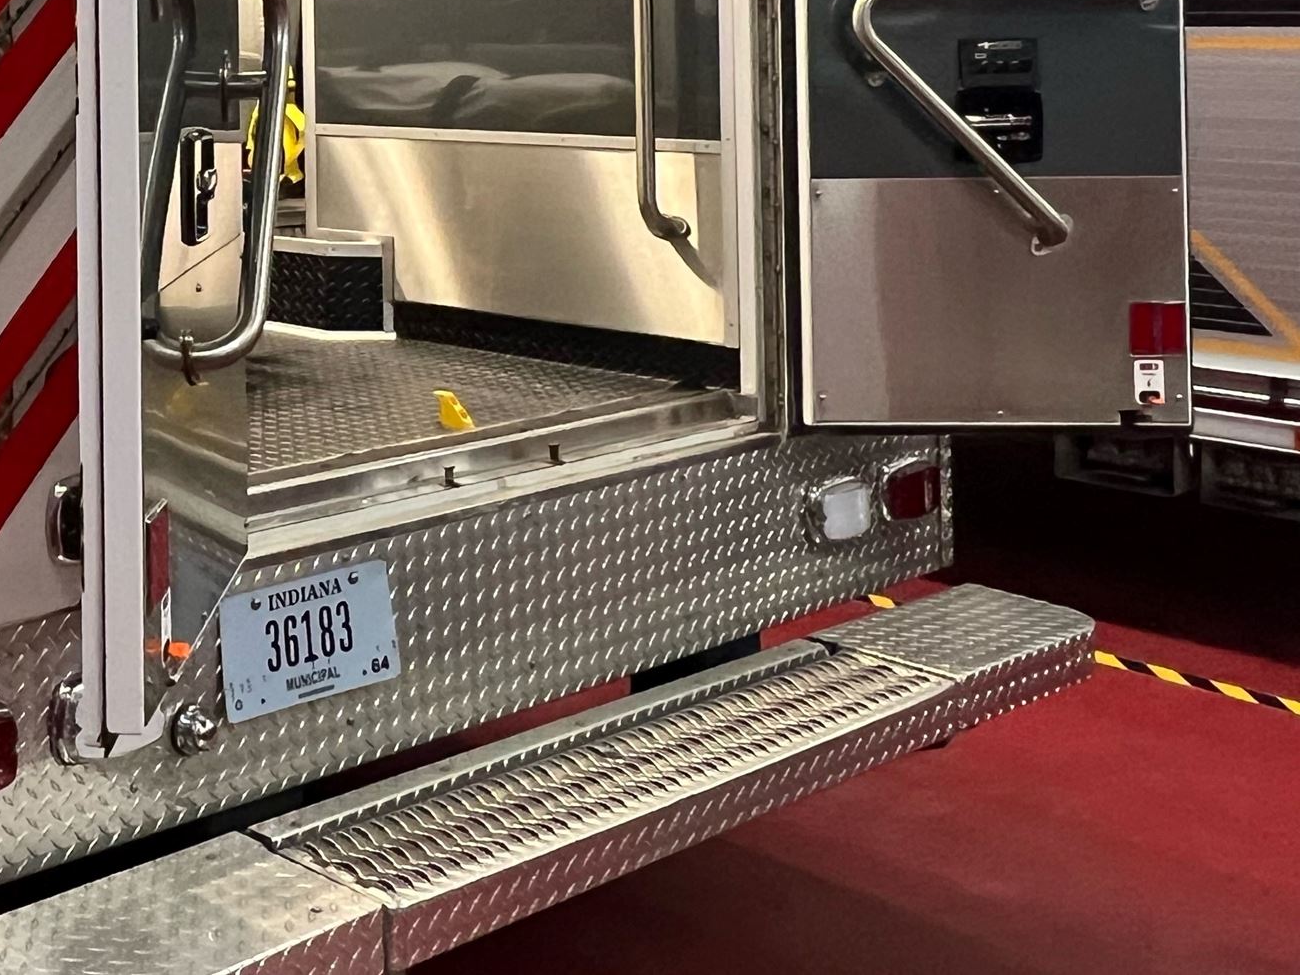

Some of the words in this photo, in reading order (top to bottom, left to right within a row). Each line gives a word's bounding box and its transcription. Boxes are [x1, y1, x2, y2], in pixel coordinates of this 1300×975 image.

[268, 578, 343, 611] INDIANA
[266, 601, 353, 672] 36183
[286, 666, 341, 691] MUNICIPAL
